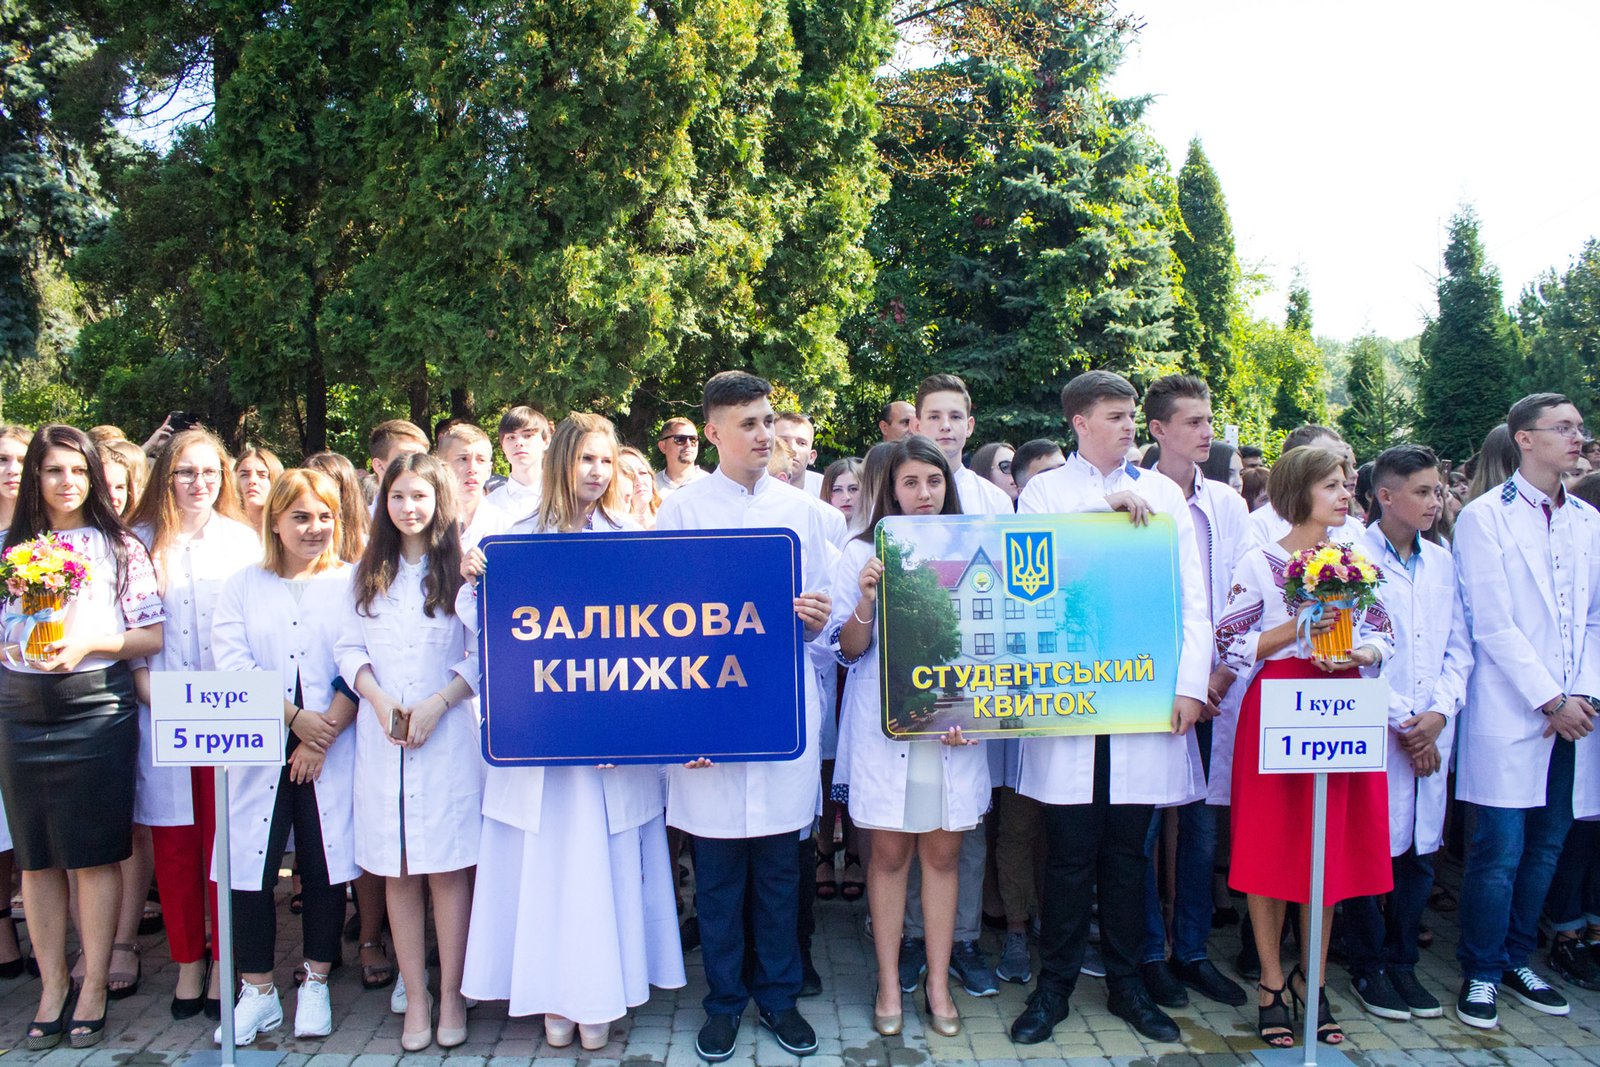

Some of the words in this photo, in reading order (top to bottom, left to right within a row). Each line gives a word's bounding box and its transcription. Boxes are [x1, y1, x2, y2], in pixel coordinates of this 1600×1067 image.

[511, 601, 766, 641] ЗАЛІКОВА
[533, 654, 748, 693] КНИЖКА
[912, 654, 1154, 692] СТУДЕНТСЬКИЙ
[200, 690, 248, 708] курс
[973, 691, 1097, 718] КВИТОК
[1309, 698, 1356, 715] курс
[174, 728, 187, 749] 5
[195, 733, 263, 753] група
[1281, 735, 1291, 755] 1
[1301, 740, 1366, 760] група
